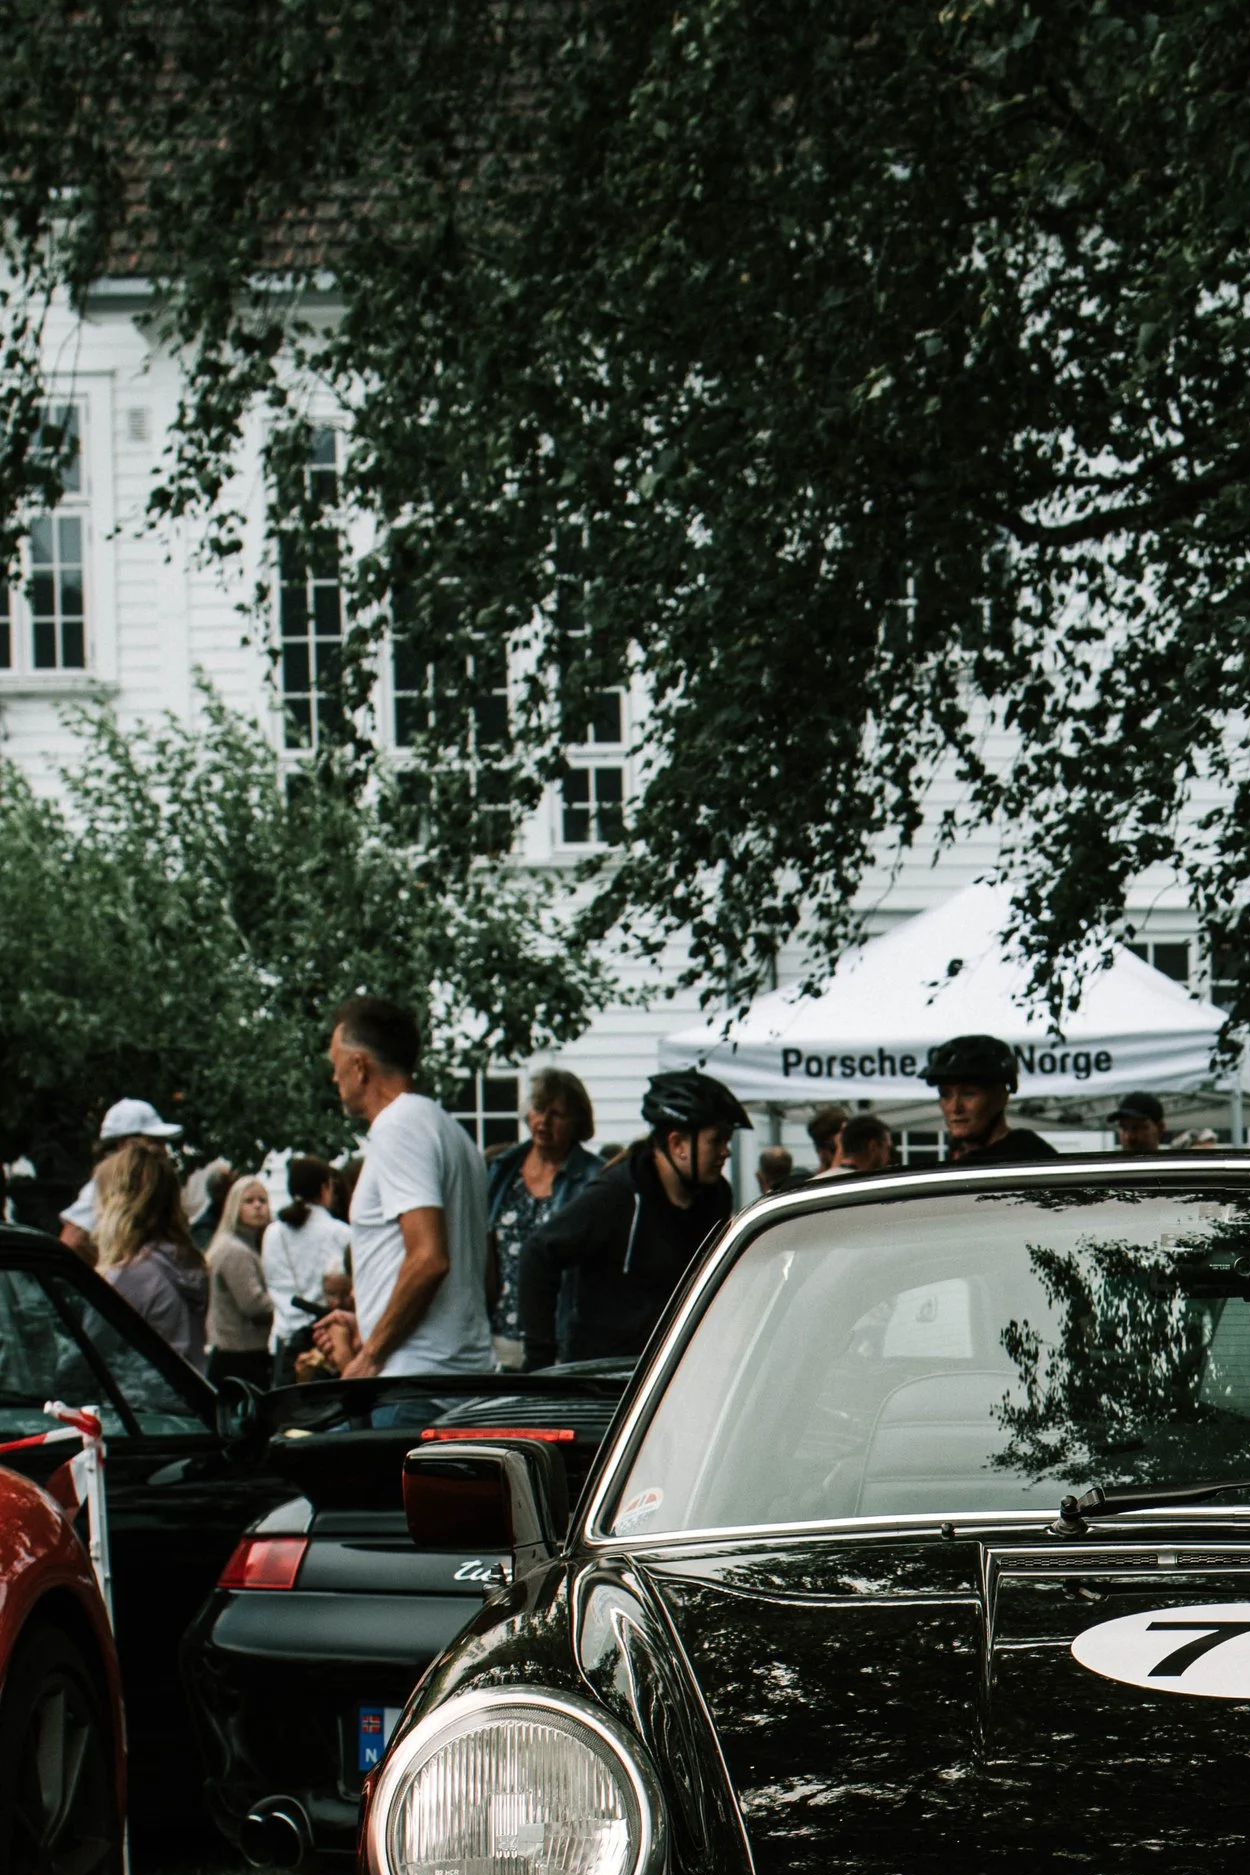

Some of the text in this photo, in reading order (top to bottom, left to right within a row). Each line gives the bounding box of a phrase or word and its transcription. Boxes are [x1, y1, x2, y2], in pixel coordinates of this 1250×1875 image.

[782, 1047, 917, 1078] Porsche
[1012, 1044, 1113, 1081] Norge
[365, 1747, 378, 1763] N
